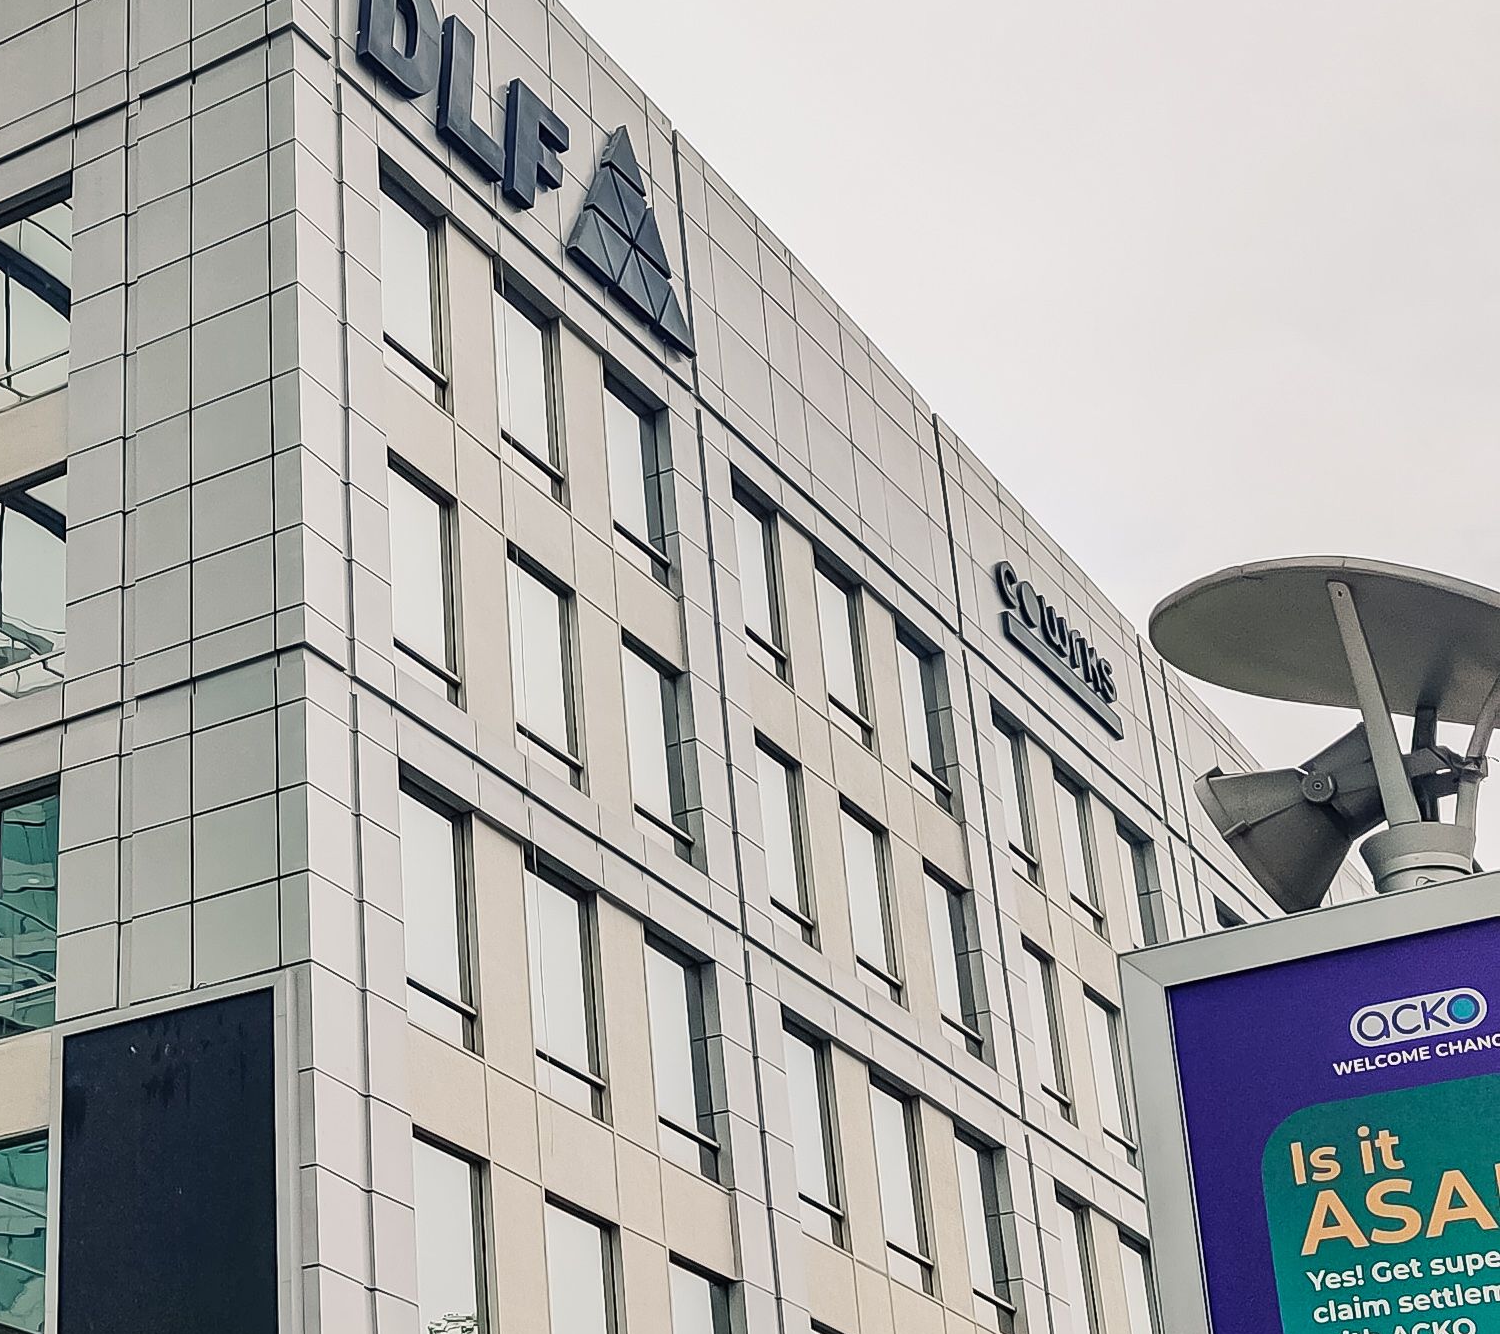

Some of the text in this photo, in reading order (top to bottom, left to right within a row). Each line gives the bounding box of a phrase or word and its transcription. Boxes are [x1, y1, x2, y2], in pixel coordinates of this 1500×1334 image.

[1332, 1045, 1432, 1076] WELCOME
[1290, 1125, 1406, 1186] Is it
[1300, 1163, 1500, 1257] ASA
[1306, 1265, 1365, 1292] Yes!
[1371, 1258, 1423, 1283] Get
[1313, 1296, 1391, 1324] claim
